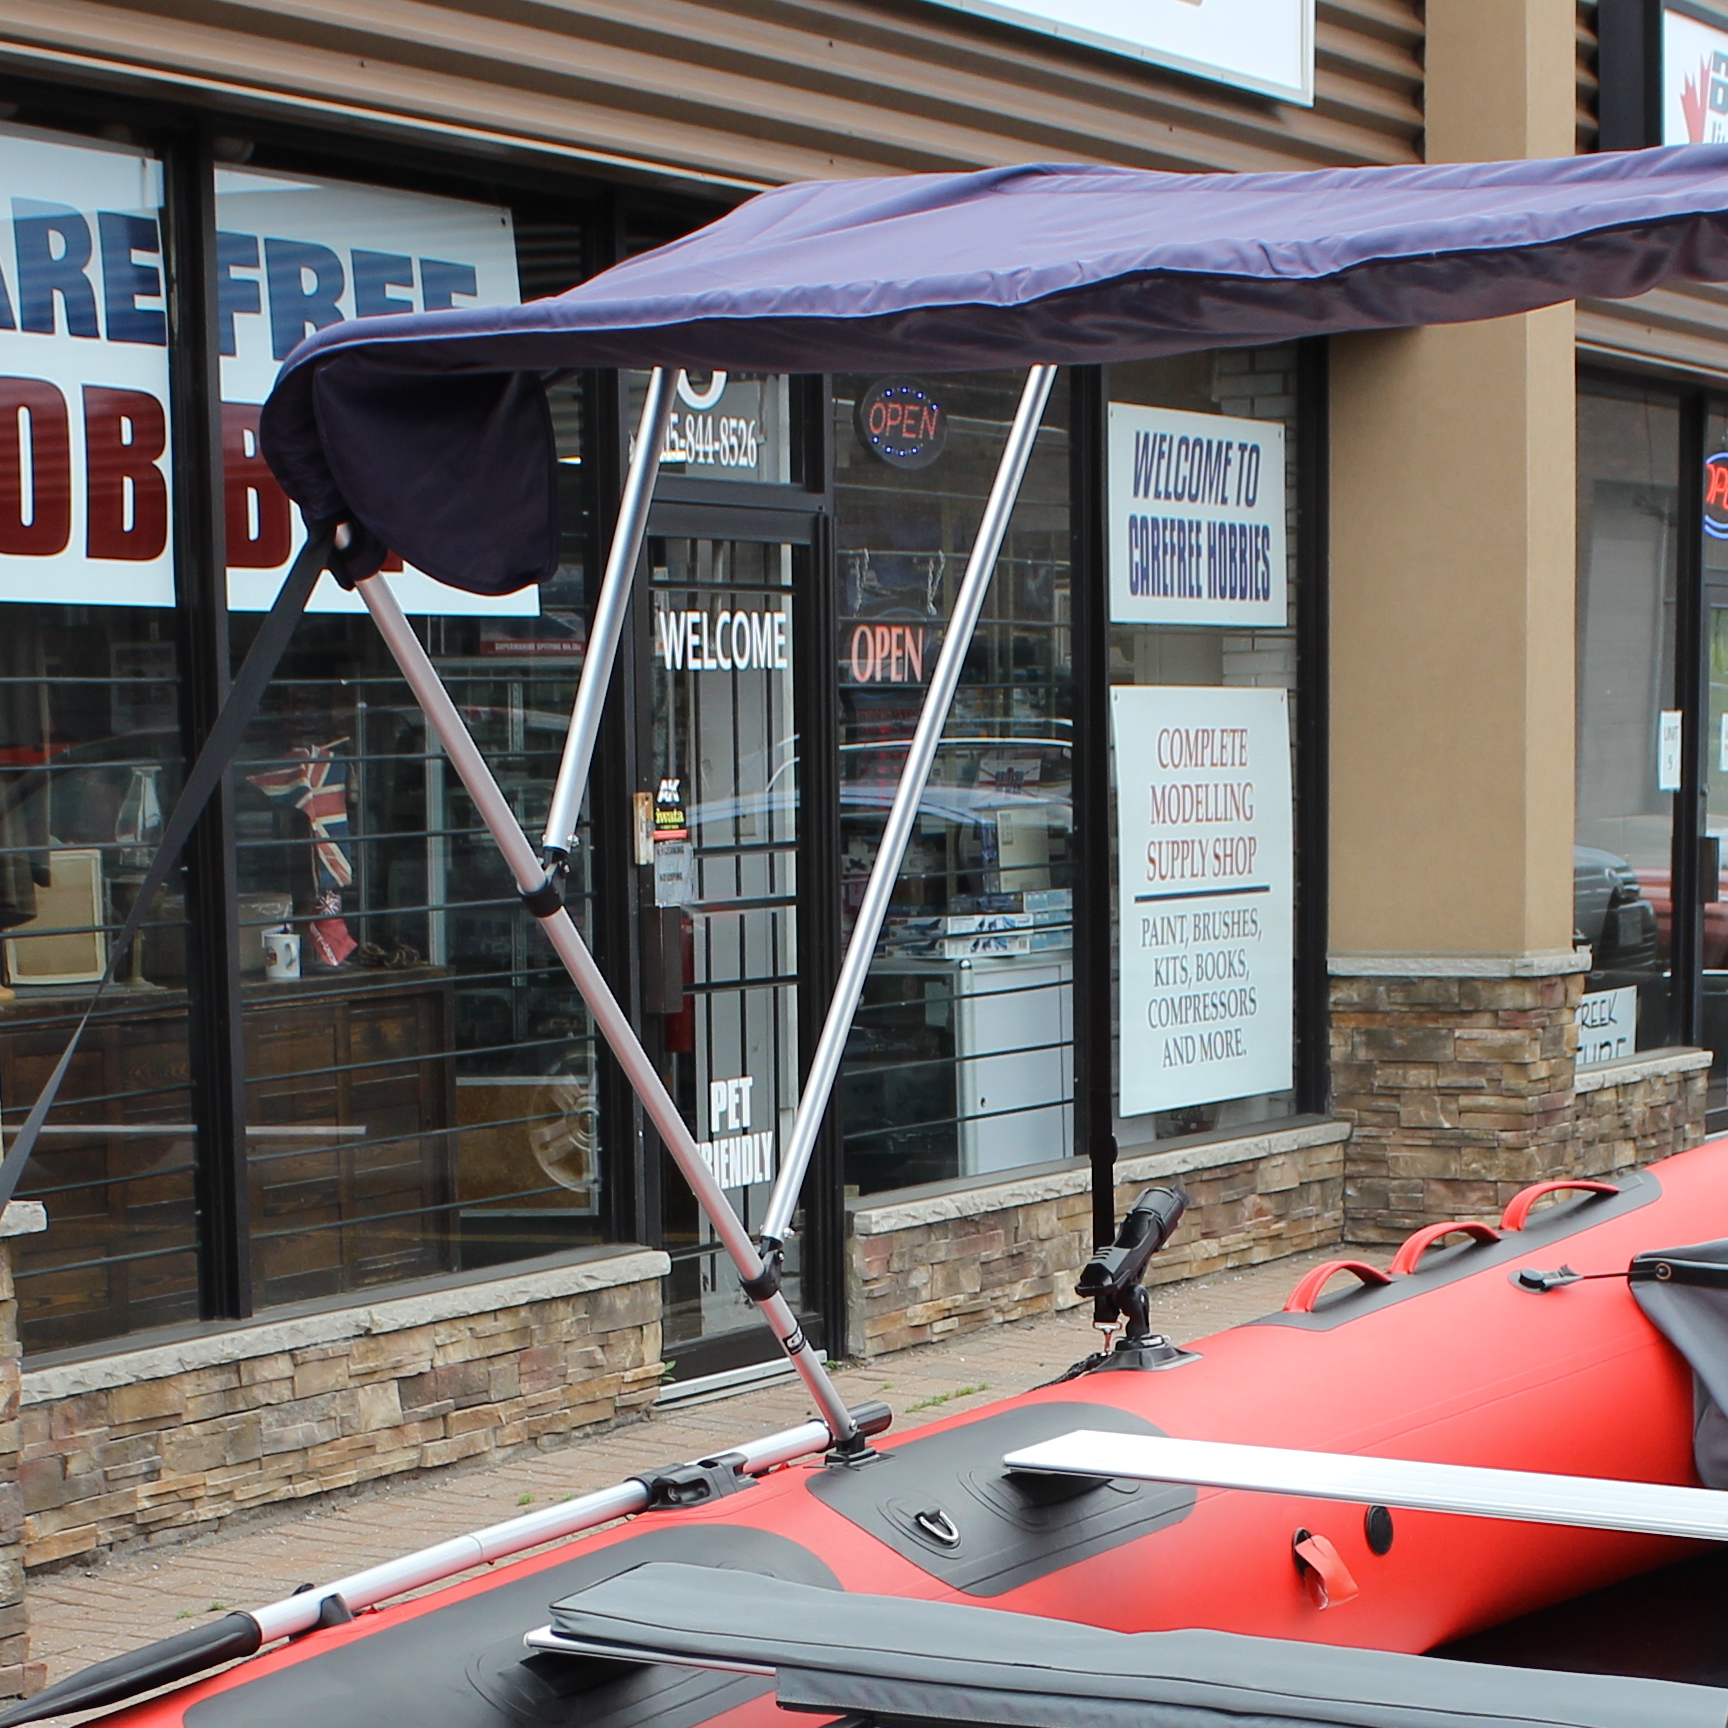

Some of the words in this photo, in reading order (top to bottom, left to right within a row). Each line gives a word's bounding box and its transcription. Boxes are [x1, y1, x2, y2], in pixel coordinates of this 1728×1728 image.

[869, 401, 940, 440] OPEN
[1132, 430, 1234, 506] WELCOME
[1236, 441, 1261, 508] TO
[1129, 513, 1202, 600] CAREFREE
[1207, 520, 1270, 601] HOBBIES
[658, 610, 788, 671] WELCOME
[851, 624, 923, 683] OPEN
[1157, 727, 1248, 770] COMPLETE
[656, 808, 685, 824] iwata
[1150, 782, 1254, 826] MODELLING
[1146, 839, 1209, 882] SUPPLY
[1212, 836, 1258, 878] SHOP
[1140, 914, 1191, 949] PAINT,
[1192, 907, 1263, 945] BRUSHES,
[1153, 954, 1192, 990] KITS,
[1195, 948, 1251, 983] BOOKS,
[1147, 987, 1258, 1030] COMPRESSORS
[1574, 991, 1618, 1031] REEK
[1162, 1032, 1197, 1069] AND
[1199, 1029, 1247, 1064] MORE.
[710, 1076, 753, 1133] PET
